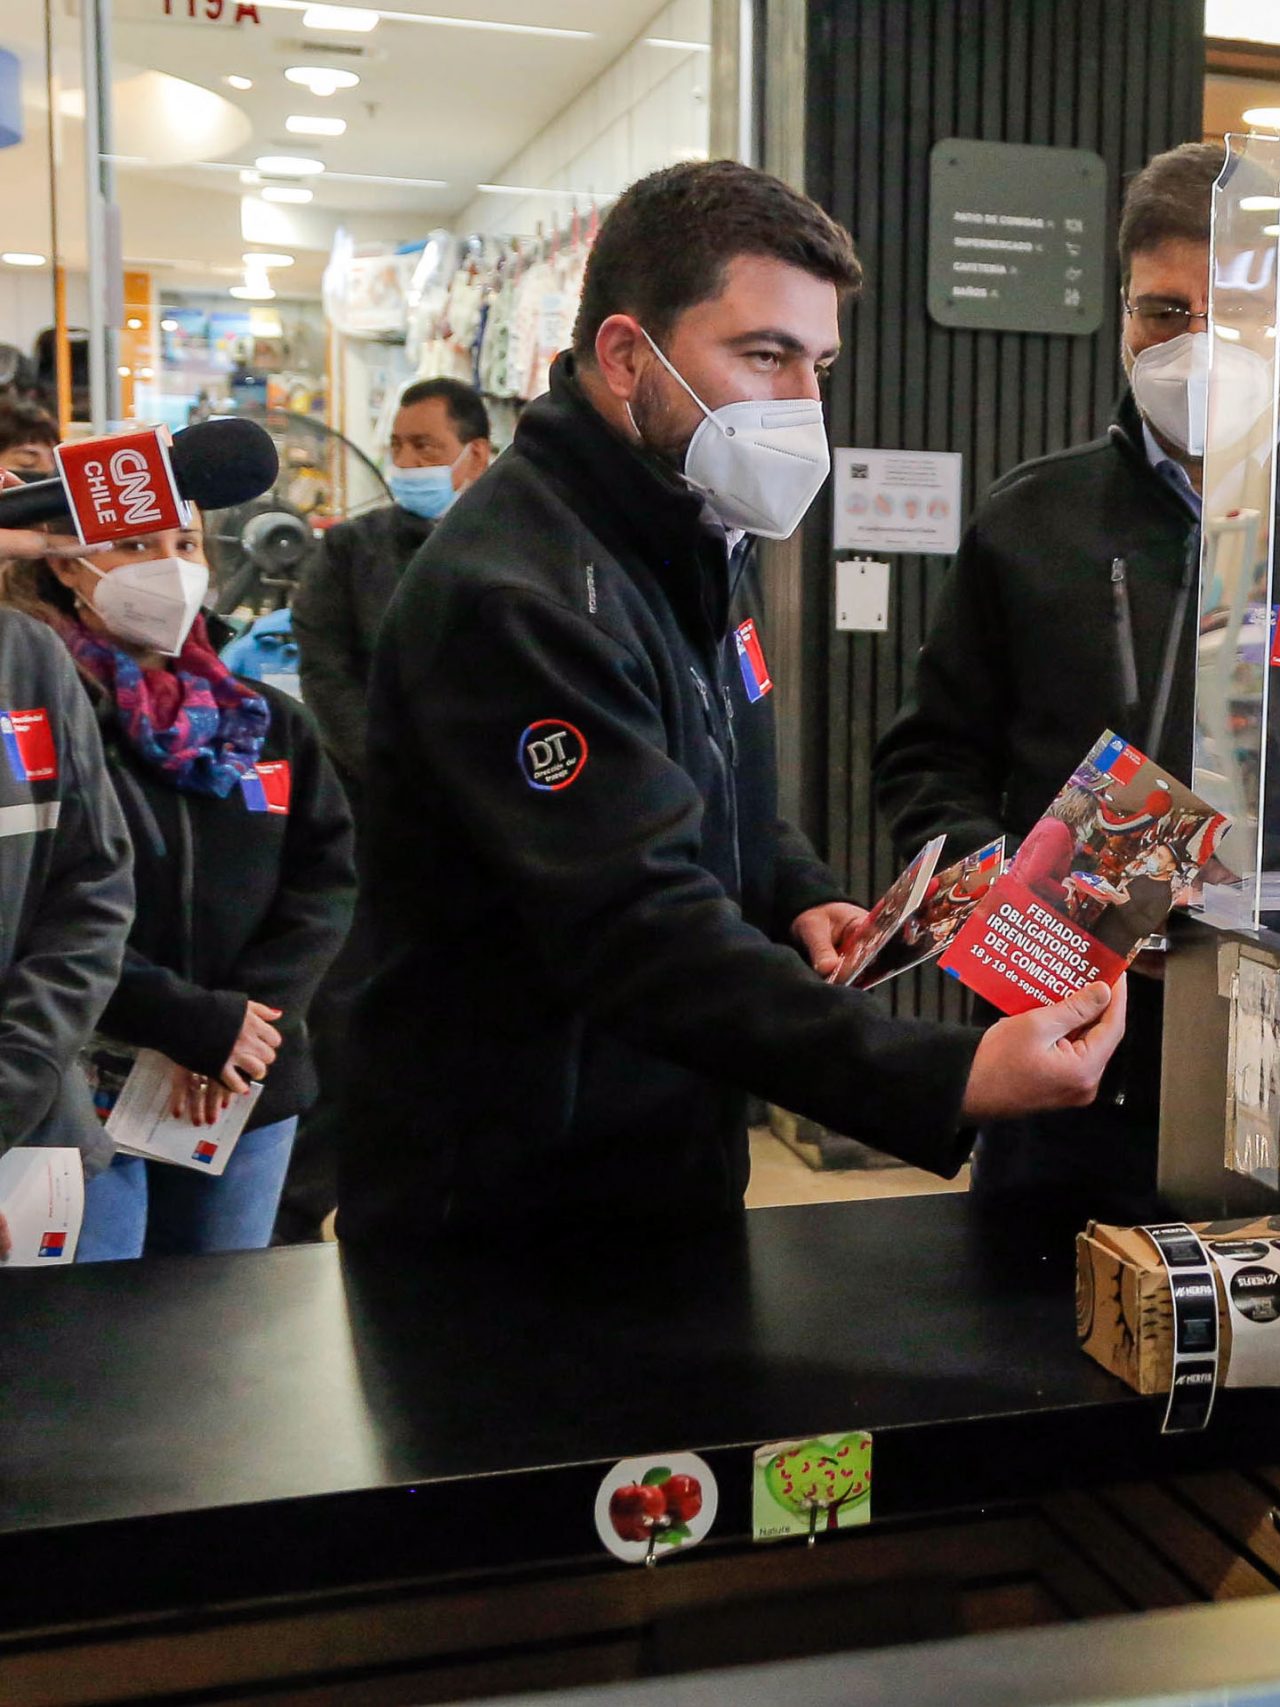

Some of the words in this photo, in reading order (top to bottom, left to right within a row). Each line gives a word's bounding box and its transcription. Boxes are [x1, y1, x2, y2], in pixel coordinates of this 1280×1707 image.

[84, 461, 117, 524] CHILE
[109, 449, 161, 524] CNN
[527, 731, 567, 770] DT
[999, 903, 1089, 973] OBLIGATORIOS
[1087, 966, 1100, 980] E
[1026, 903, 1090, 954] FERIADOS
[970, 944, 985, 958] 18
[982, 955, 992, 964] y
[992, 959, 1007, 973] 19
[1005, 969, 1018, 982] de
[1018, 977, 1056, 1006] septiem
[983, 931, 1008, 957] DEL
[1010, 950, 1076, 999] COMERCIO
